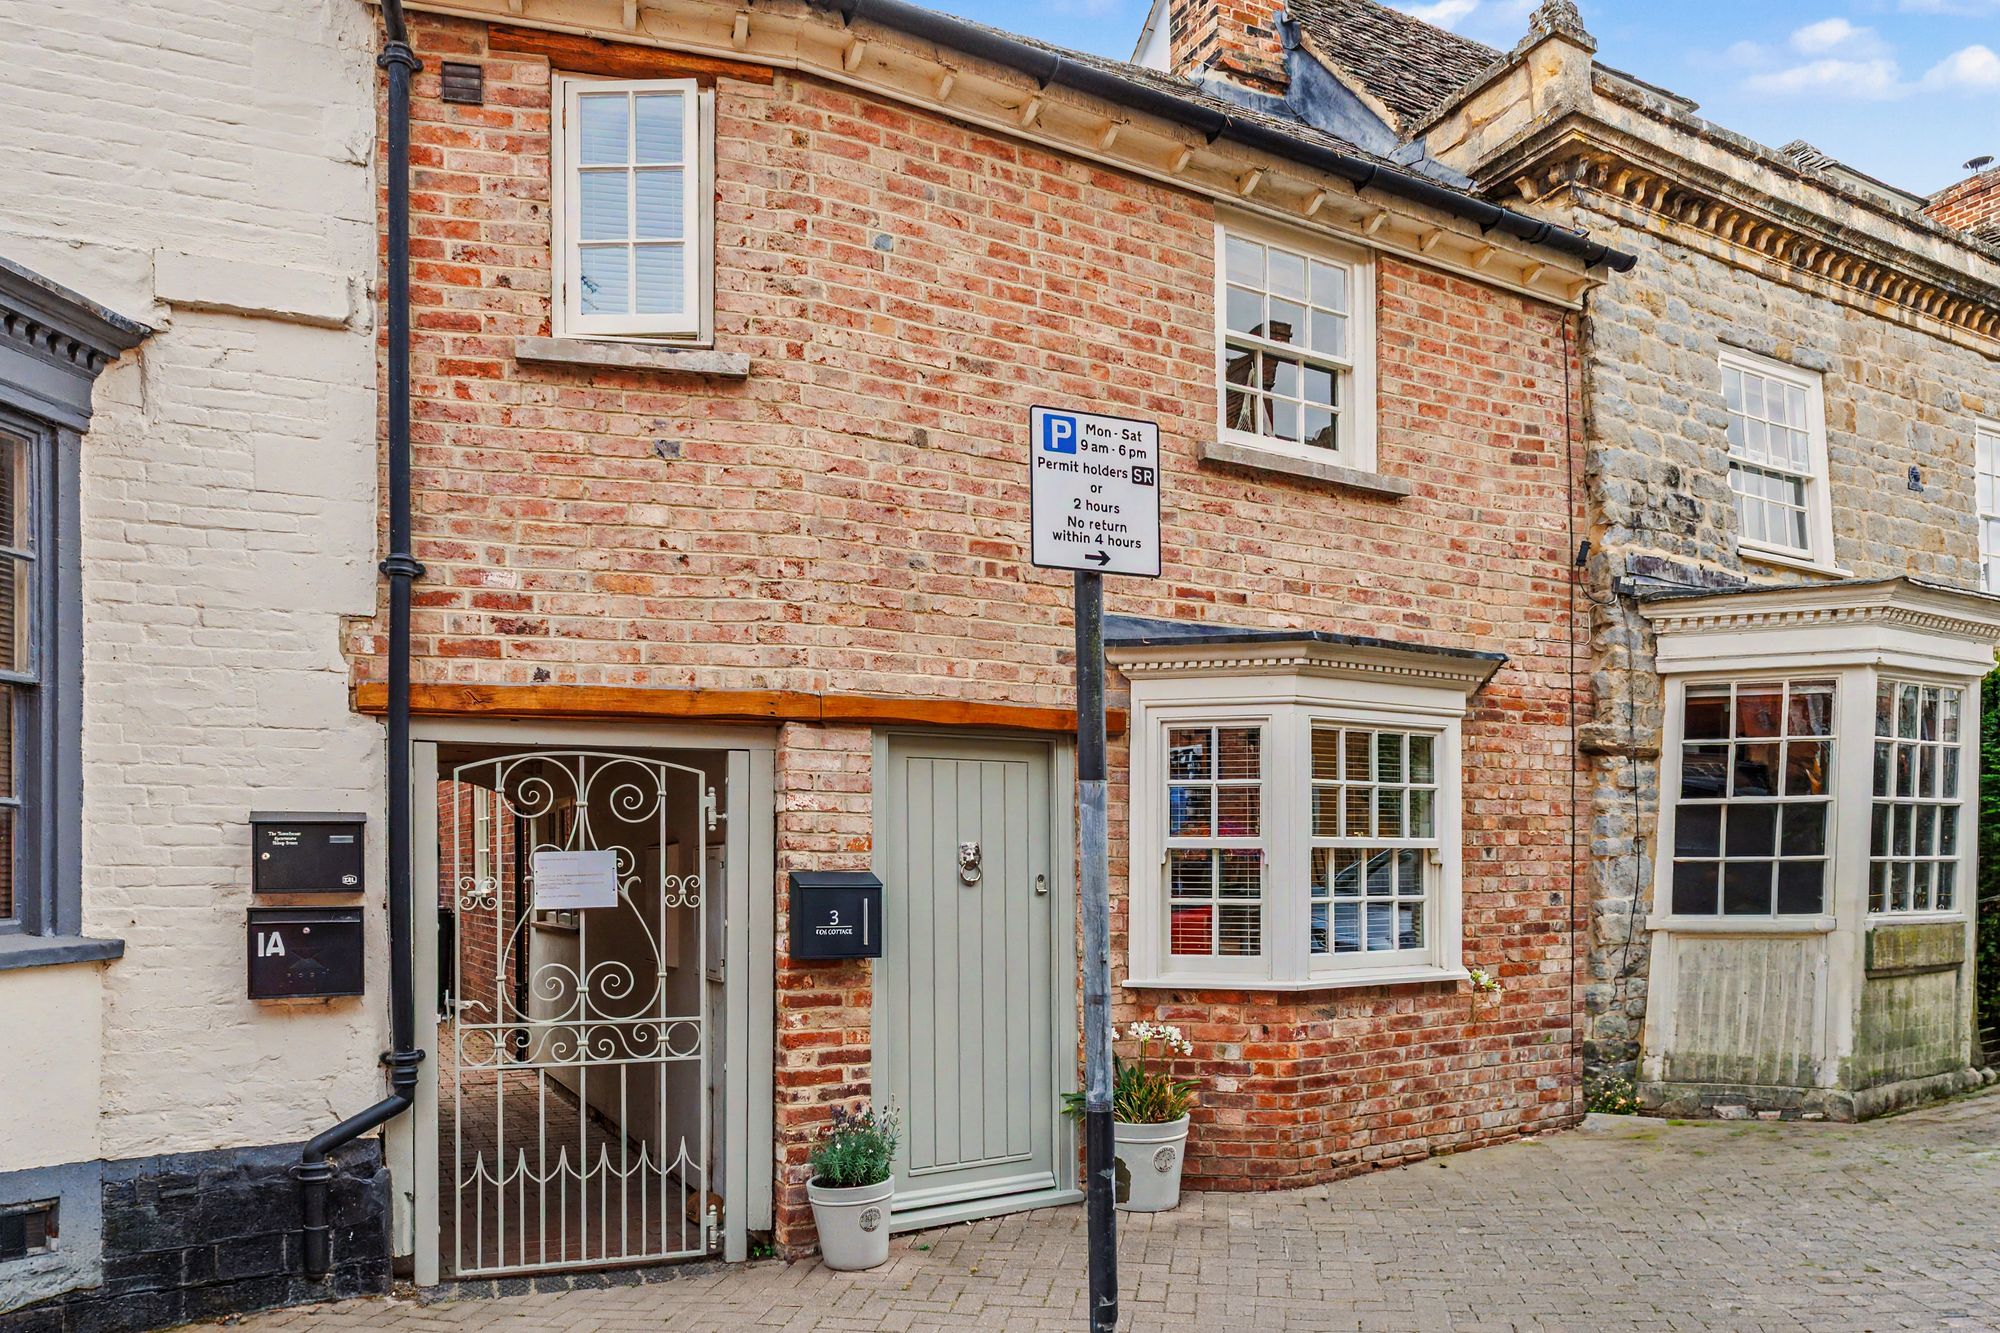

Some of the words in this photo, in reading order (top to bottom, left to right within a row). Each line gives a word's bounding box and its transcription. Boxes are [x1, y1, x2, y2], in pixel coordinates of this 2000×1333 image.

[1052, 419, 1071, 448] P
[1122, 429, 1142, 442] Sat
[1038, 457, 1079, 472] Permit
[1084, 463, 1128, 478] holders
[1133, 468, 1152, 484] SR
[1091, 484, 1102, 493] or
[1074, 498, 1081, 509] 2
[1086, 500, 1120, 513] hours
[1068, 516, 1084, 528] No
[1090, 519, 1127, 533] return
[1053, 530, 1090, 543] within
[1095, 534, 1103, 545] 4
[1108, 535, 1142, 549] hours
[829, 910, 839, 926] 3
